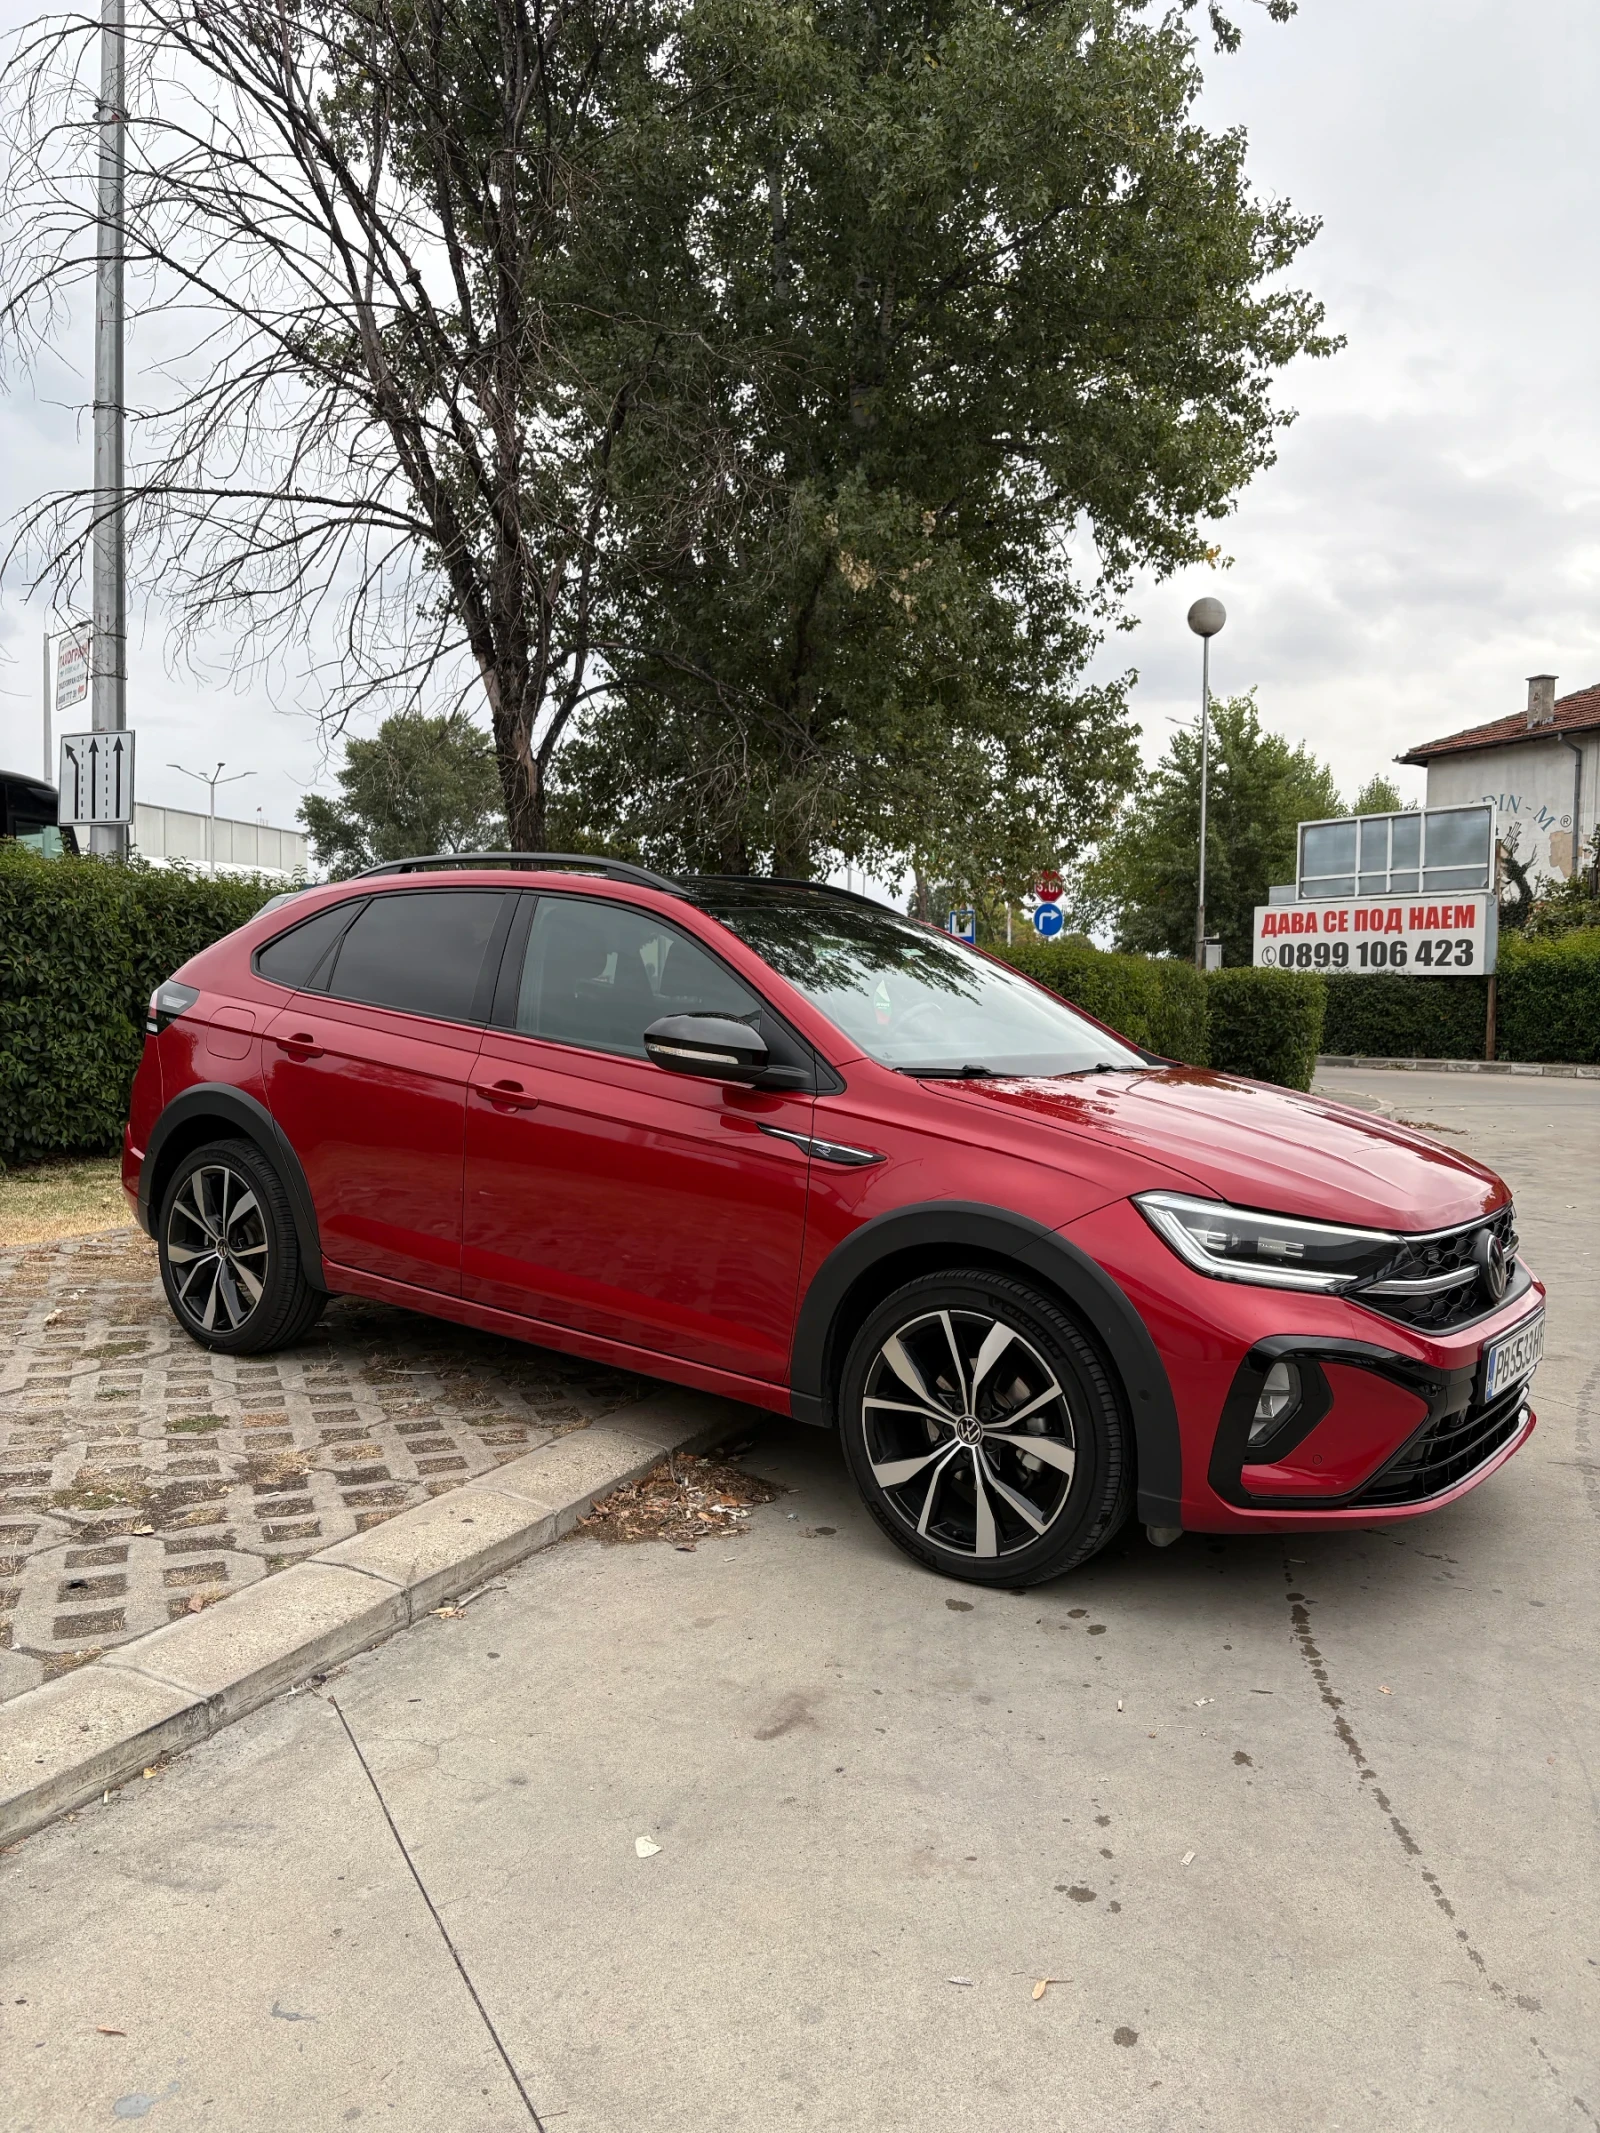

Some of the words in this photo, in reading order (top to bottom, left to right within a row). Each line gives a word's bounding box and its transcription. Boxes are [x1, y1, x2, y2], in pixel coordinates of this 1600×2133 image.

[1036, 880, 1060, 893] SO
[1261, 912, 1318, 938] ДАВА
[1323, 910, 1349, 933] СЕ
[1354, 907, 1403, 934] ПОД
[1409, 904, 1475, 930] НАЕМ
[1278, 942, 1349, 968] 0899
[1356, 940, 1408, 967] 106
[1415, 939, 1474, 967] 423
